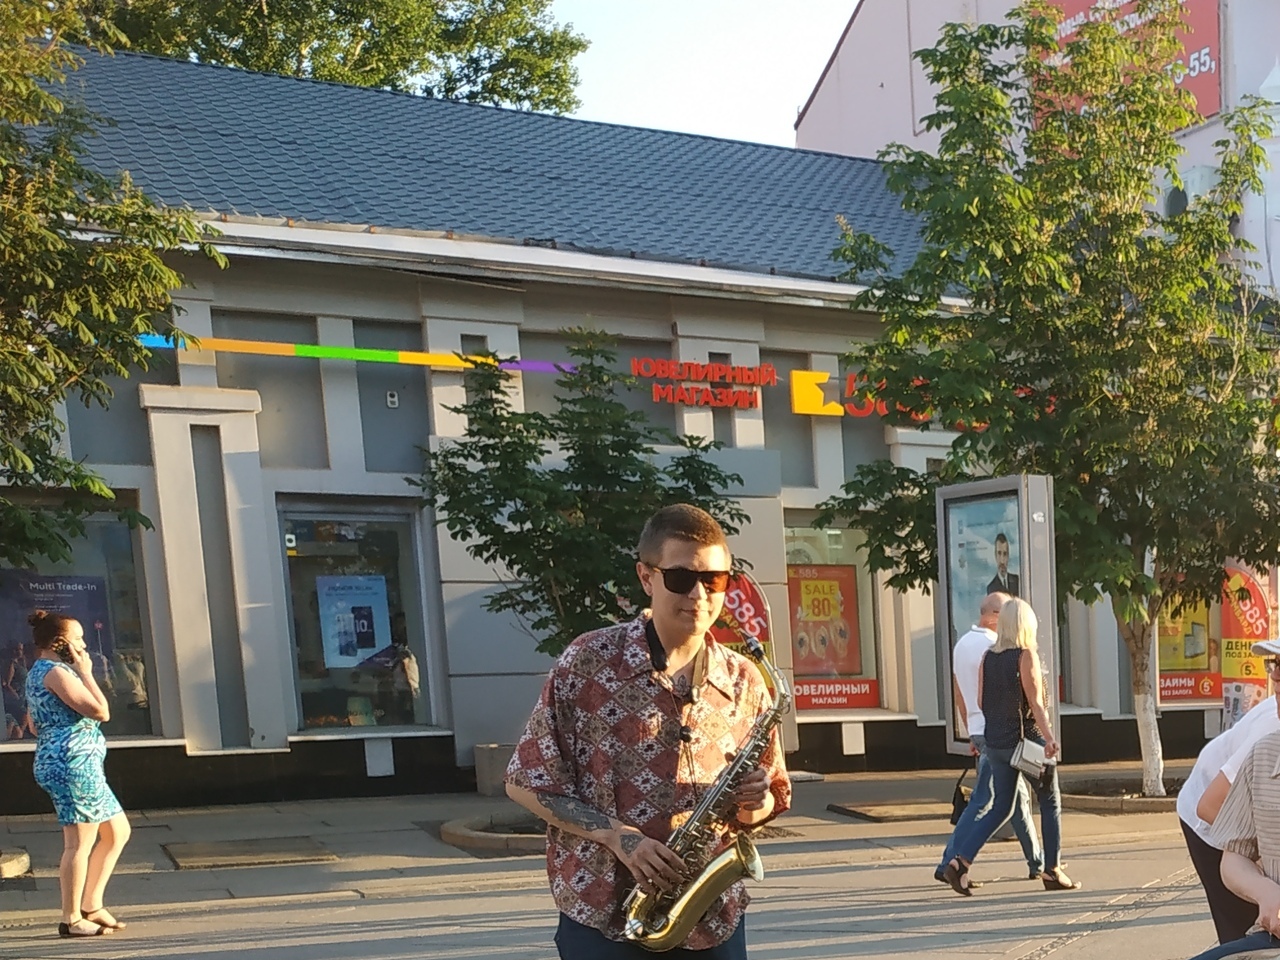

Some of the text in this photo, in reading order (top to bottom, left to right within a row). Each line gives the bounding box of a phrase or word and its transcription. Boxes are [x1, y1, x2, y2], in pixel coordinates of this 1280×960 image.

[630, 357, 777, 386] ЮВЕЛИРНЫЙ
[652, 383, 759, 409] МАГАЗИН
[29, 582, 55, 591] Multi
[804, 584, 836, 596] SALE
[724, 589, 767, 637] 585
